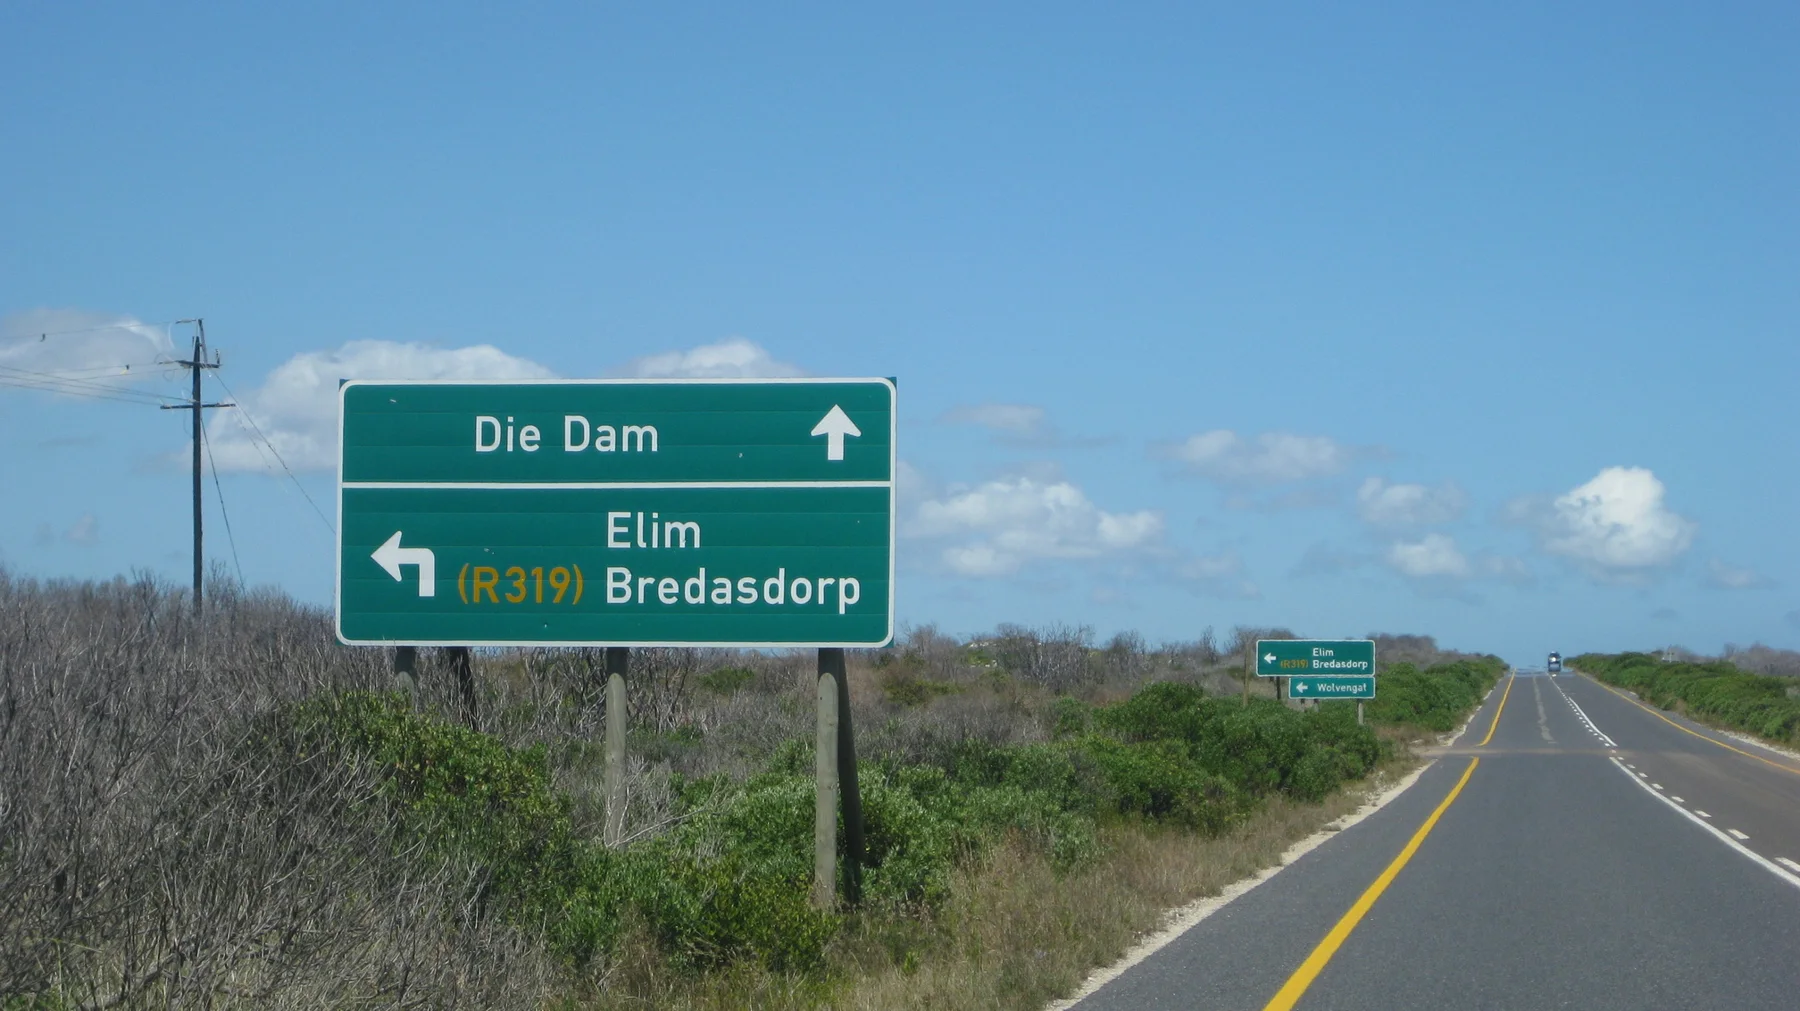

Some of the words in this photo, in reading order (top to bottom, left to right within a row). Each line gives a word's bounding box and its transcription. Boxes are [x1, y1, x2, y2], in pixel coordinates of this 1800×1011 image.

[475, 415, 541, 453] Die
[564, 415, 659, 453] Dam
[607, 511, 701, 549] Elim
[457, 563, 584, 606] (R319)
[606, 567, 861, 615] Bredasdorp
[1280, 659, 1308, 669] (R319)
[1312, 659, 1368, 670] Bredasdorp
[1312, 648, 1334, 657] Elim
[1317, 683, 1367, 694] Wolvengat
